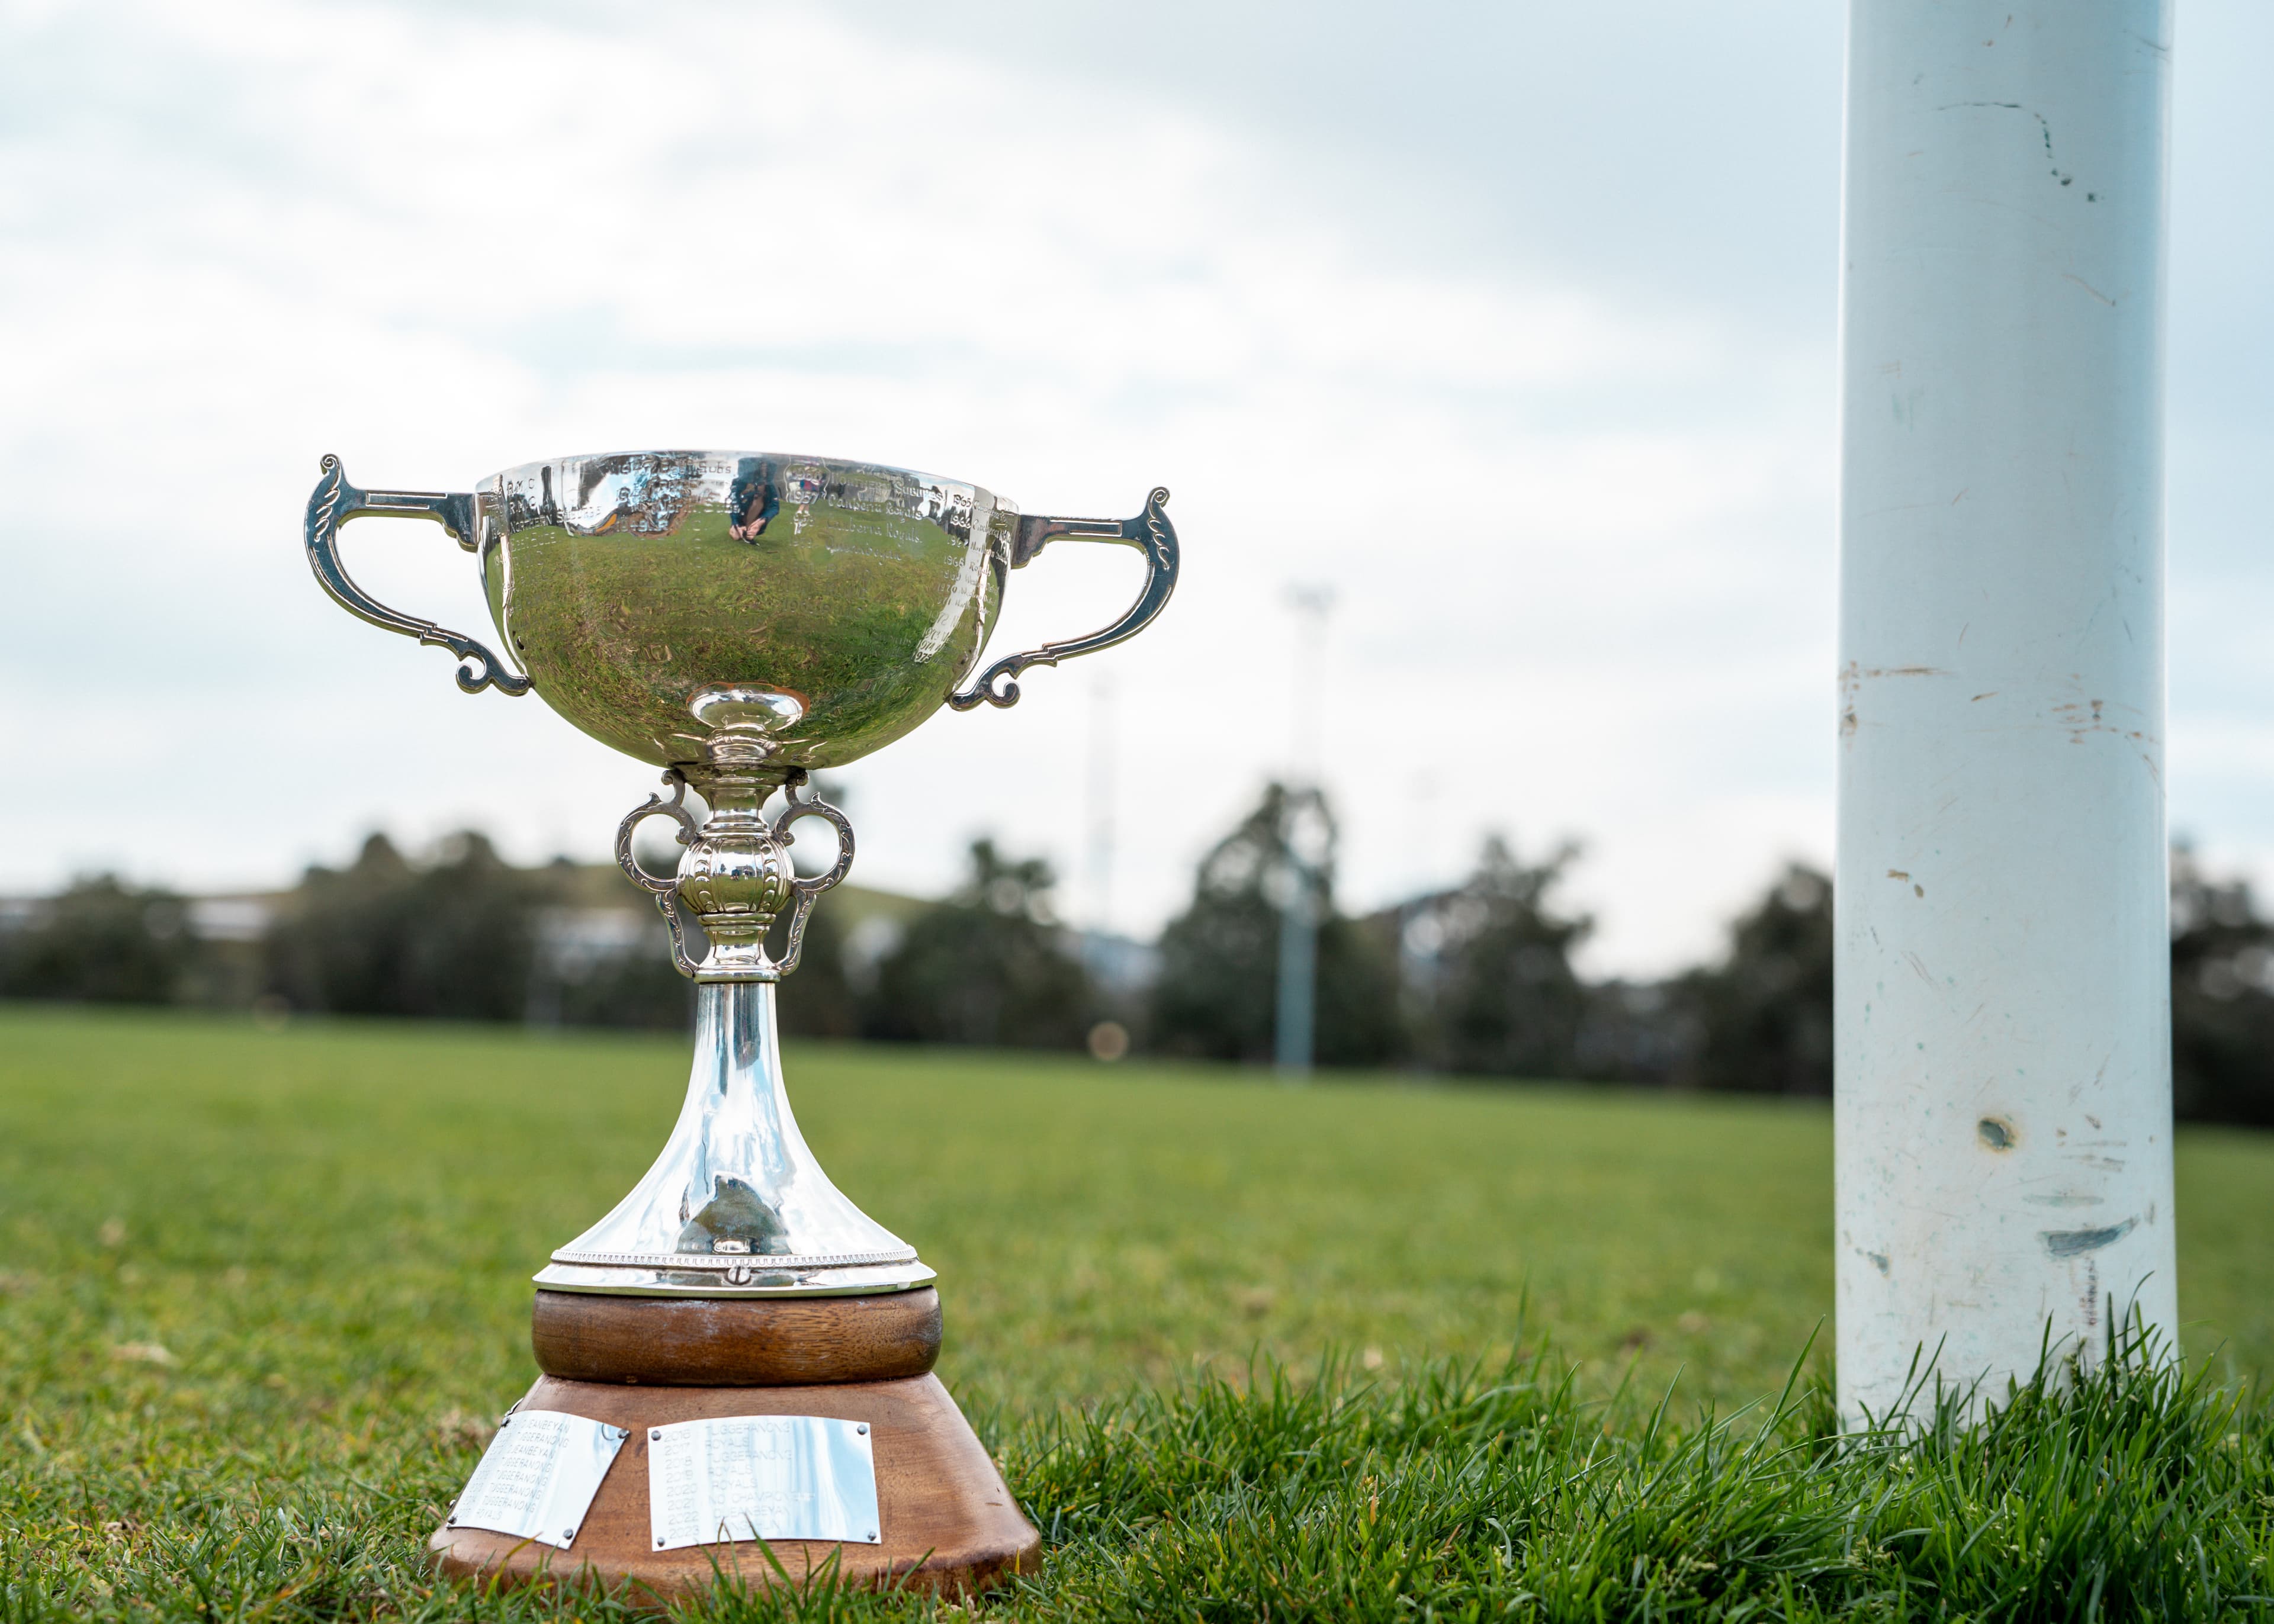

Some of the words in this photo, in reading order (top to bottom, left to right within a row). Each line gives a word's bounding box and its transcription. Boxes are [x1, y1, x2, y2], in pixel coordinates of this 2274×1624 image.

[705, 1437, 750, 1449] ROYALS
[708, 1464, 754, 1477] ROYALS
[666, 1482, 698, 1497] 2020
[711, 1477, 758, 1491] ROYALS
[708, 1494, 725, 1505] NO
[667, 1510, 699, 1526] 2022
[669, 1525, 700, 1540] 2023
